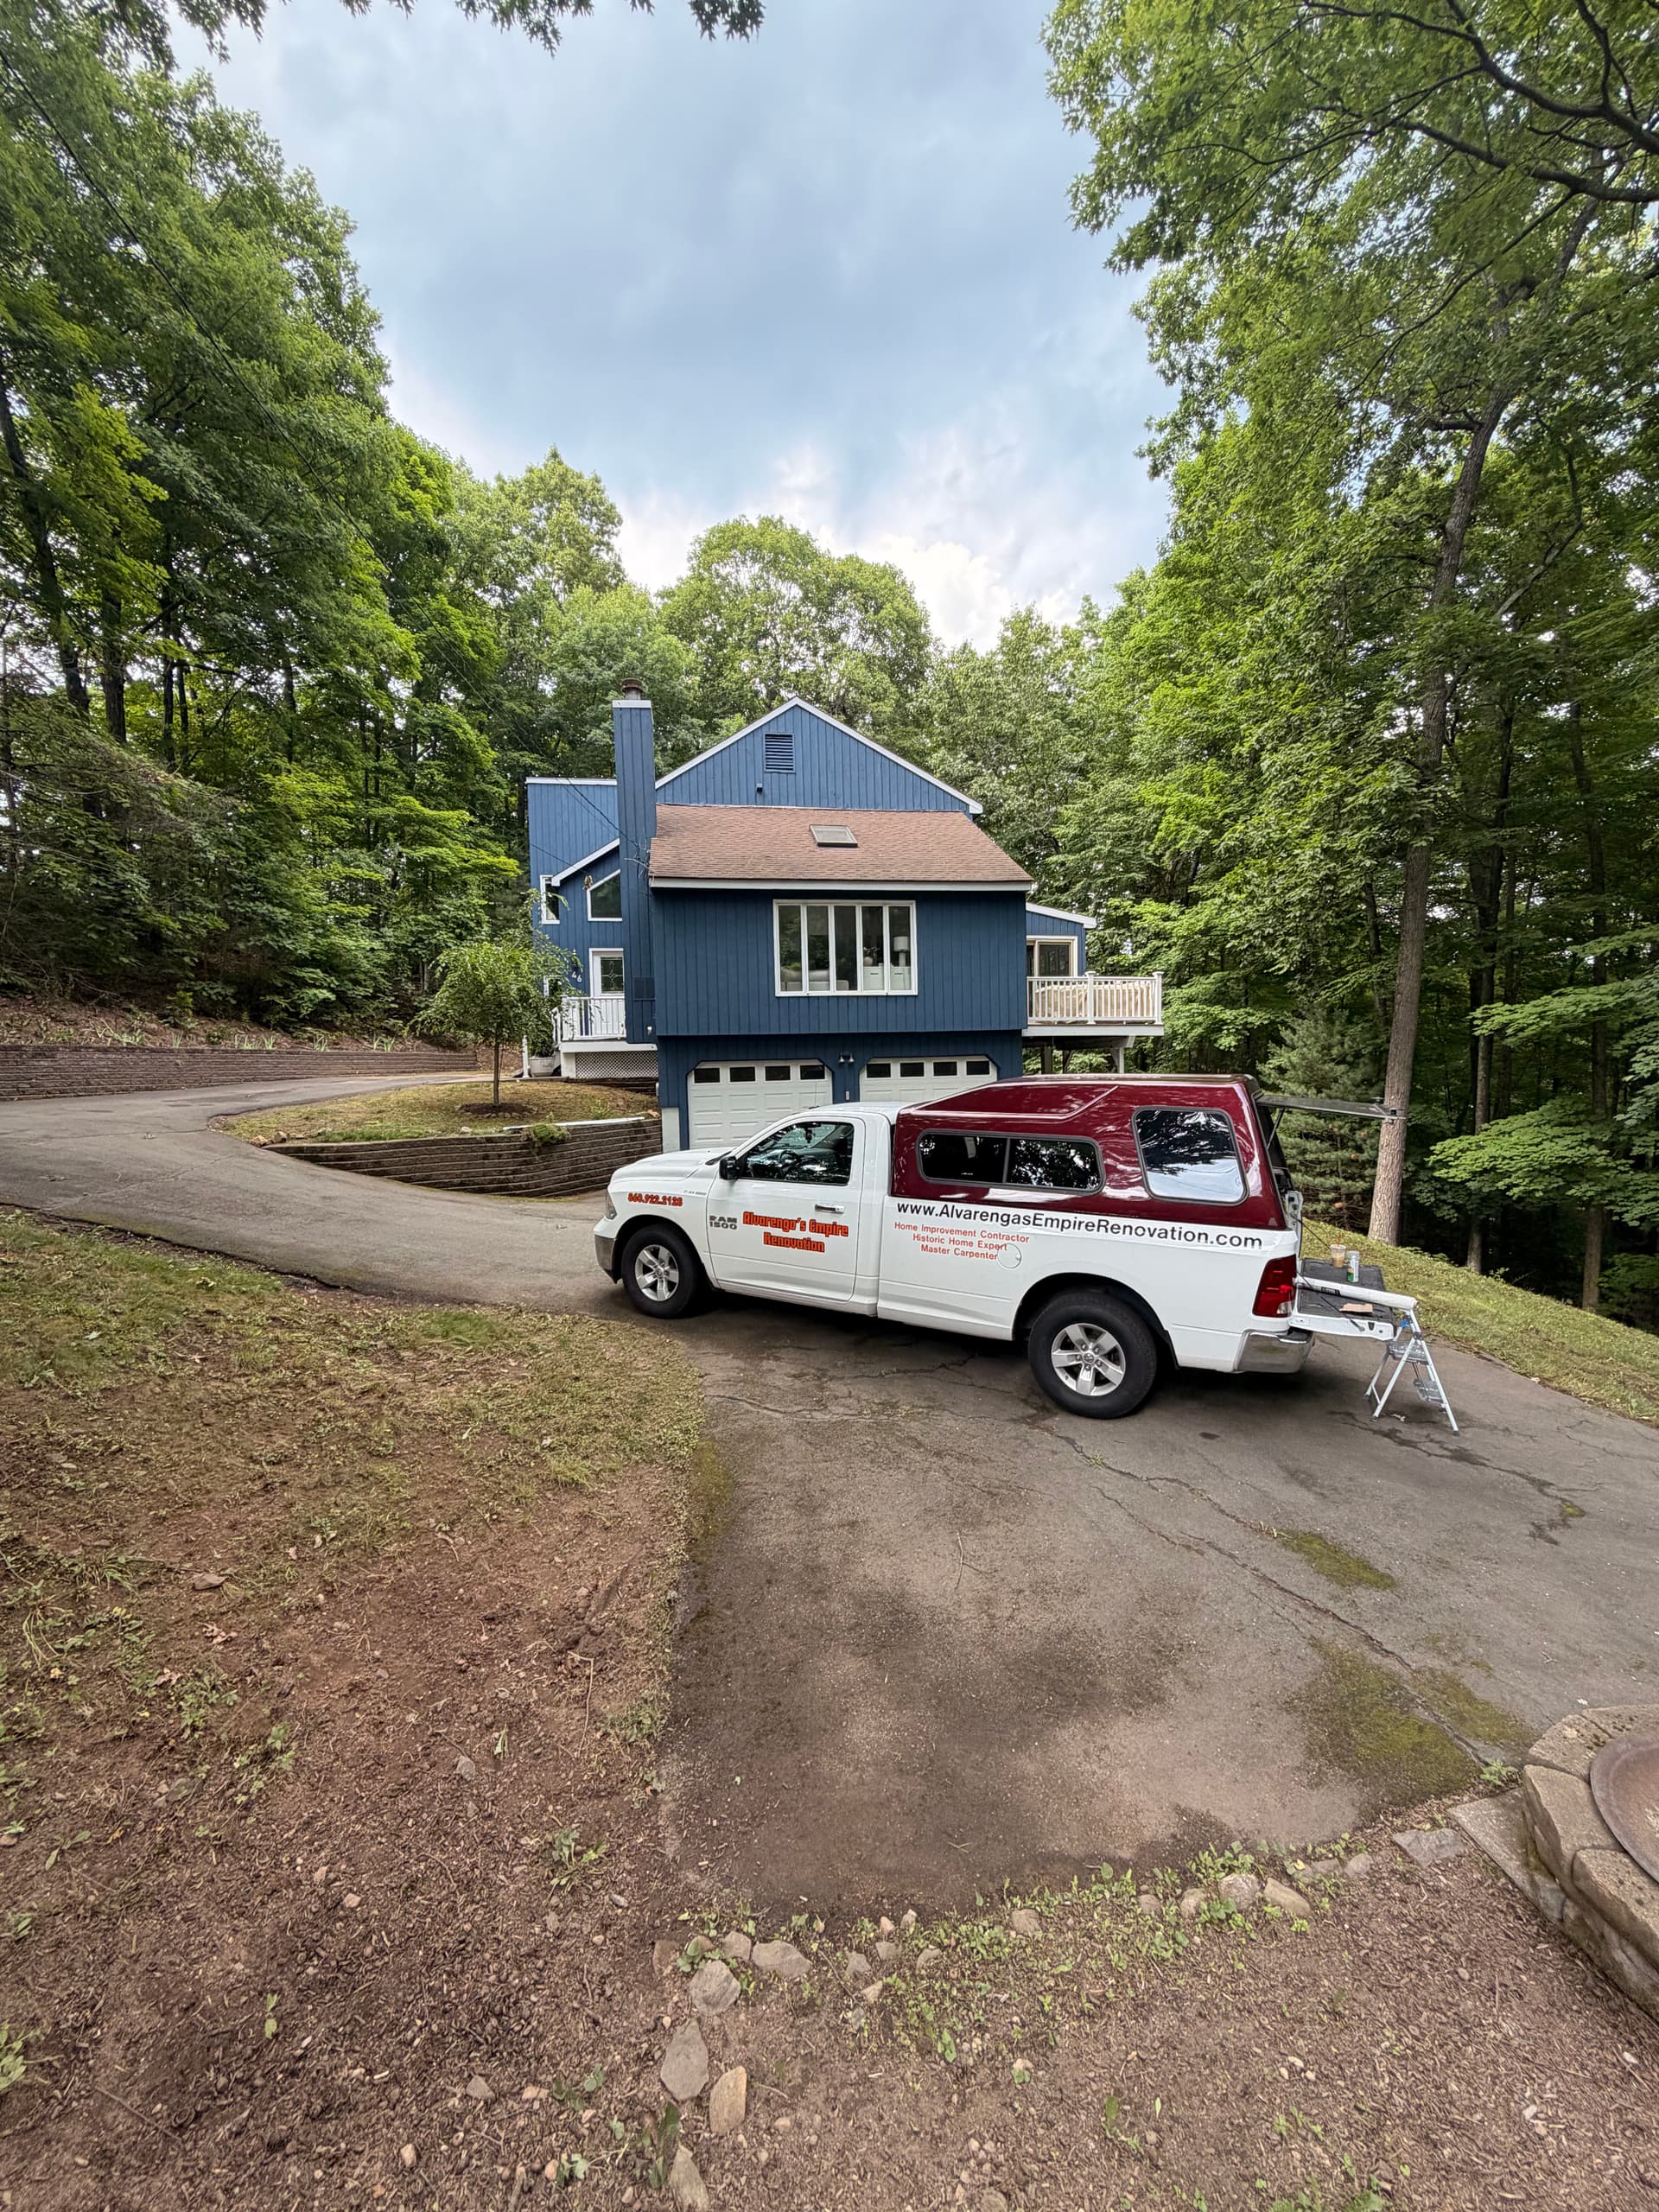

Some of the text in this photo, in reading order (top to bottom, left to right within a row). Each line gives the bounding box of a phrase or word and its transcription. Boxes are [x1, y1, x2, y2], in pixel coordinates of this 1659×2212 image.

[571, 971, 582, 982] 46
[742, 1211, 849, 1237] Alvarenga's Empire
[894, 1222, 1030, 1243] Home Improvement Contractor
[897, 1202, 1262, 1249] www.AlvarengasEmpireRenovation.com
[763, 1231, 825, 1253] Renovation
[912, 1233, 1007, 1253] Historic Home Expert
[920, 1243, 998, 1261] Master Carpenter
